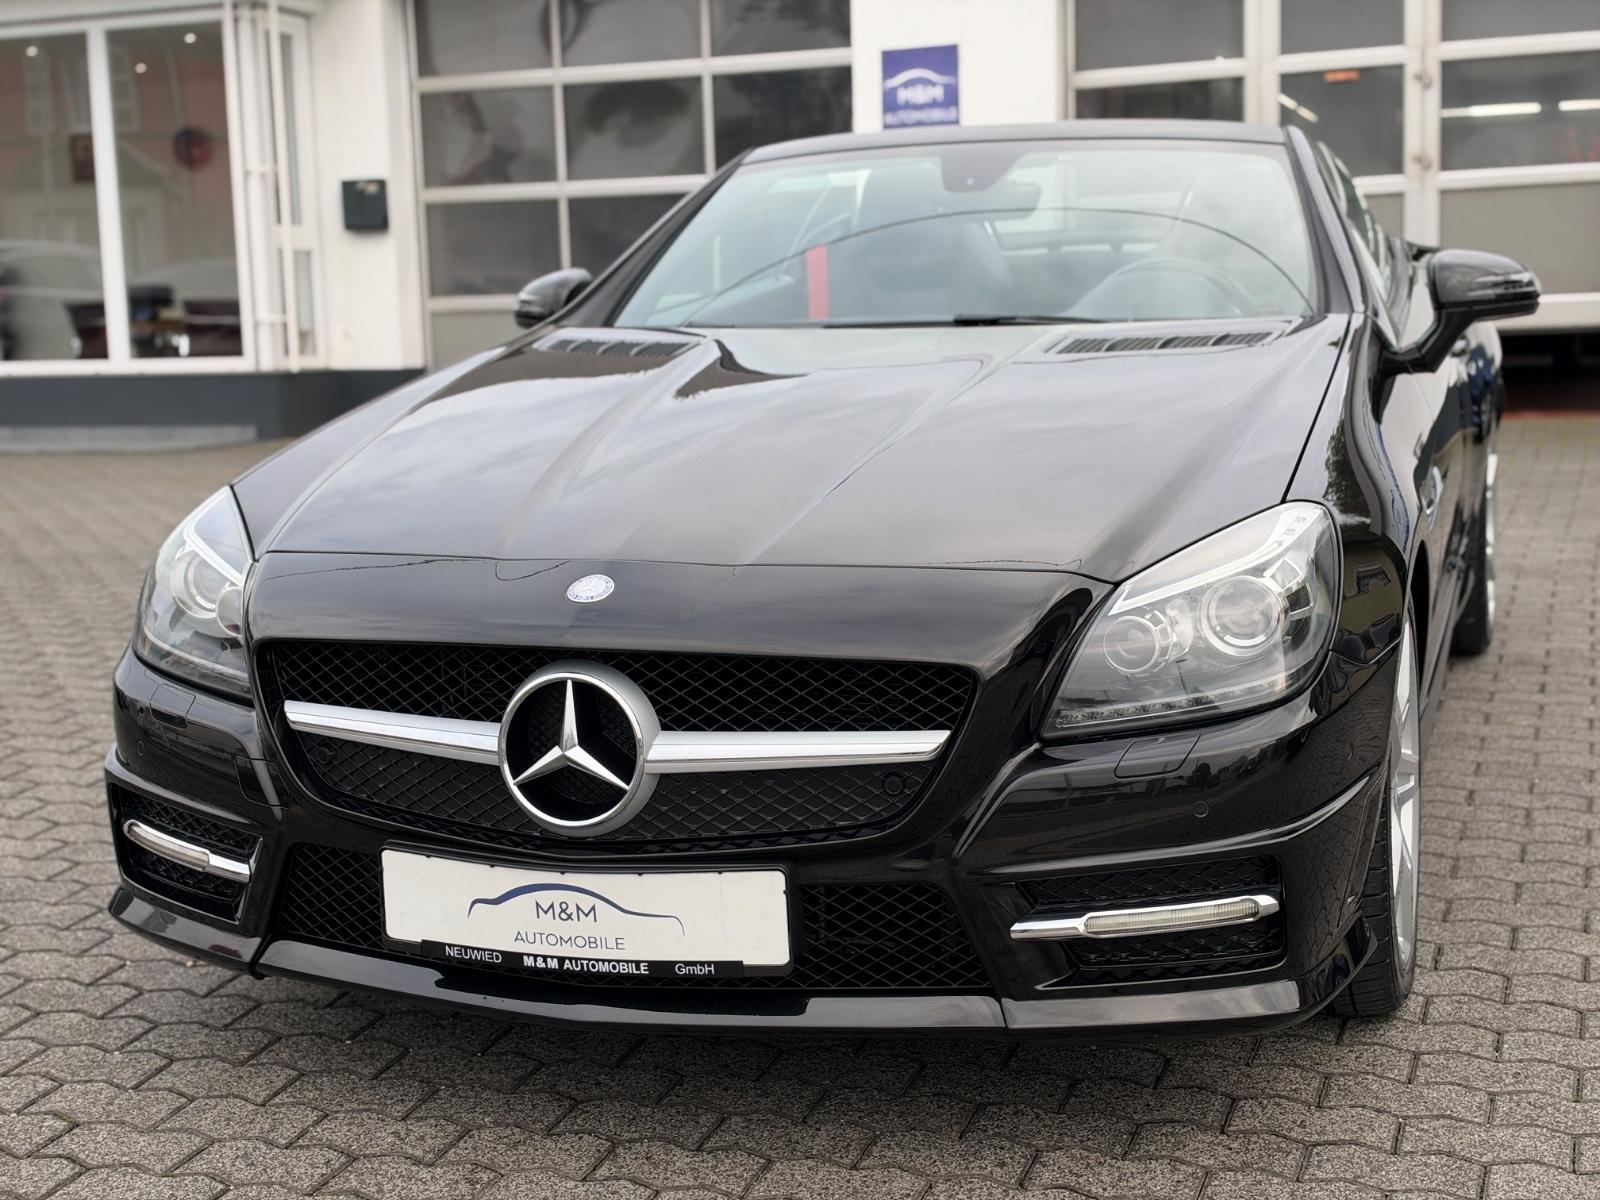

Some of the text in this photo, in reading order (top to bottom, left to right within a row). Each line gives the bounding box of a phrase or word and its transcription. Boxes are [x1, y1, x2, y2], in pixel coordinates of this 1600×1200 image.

[535, 900, 597, 922] M&M
[514, 931, 626, 950] AUTOMOBILE
[445, 945, 715, 975] NEUWIED M&M AUTOMOBILE GmbH
